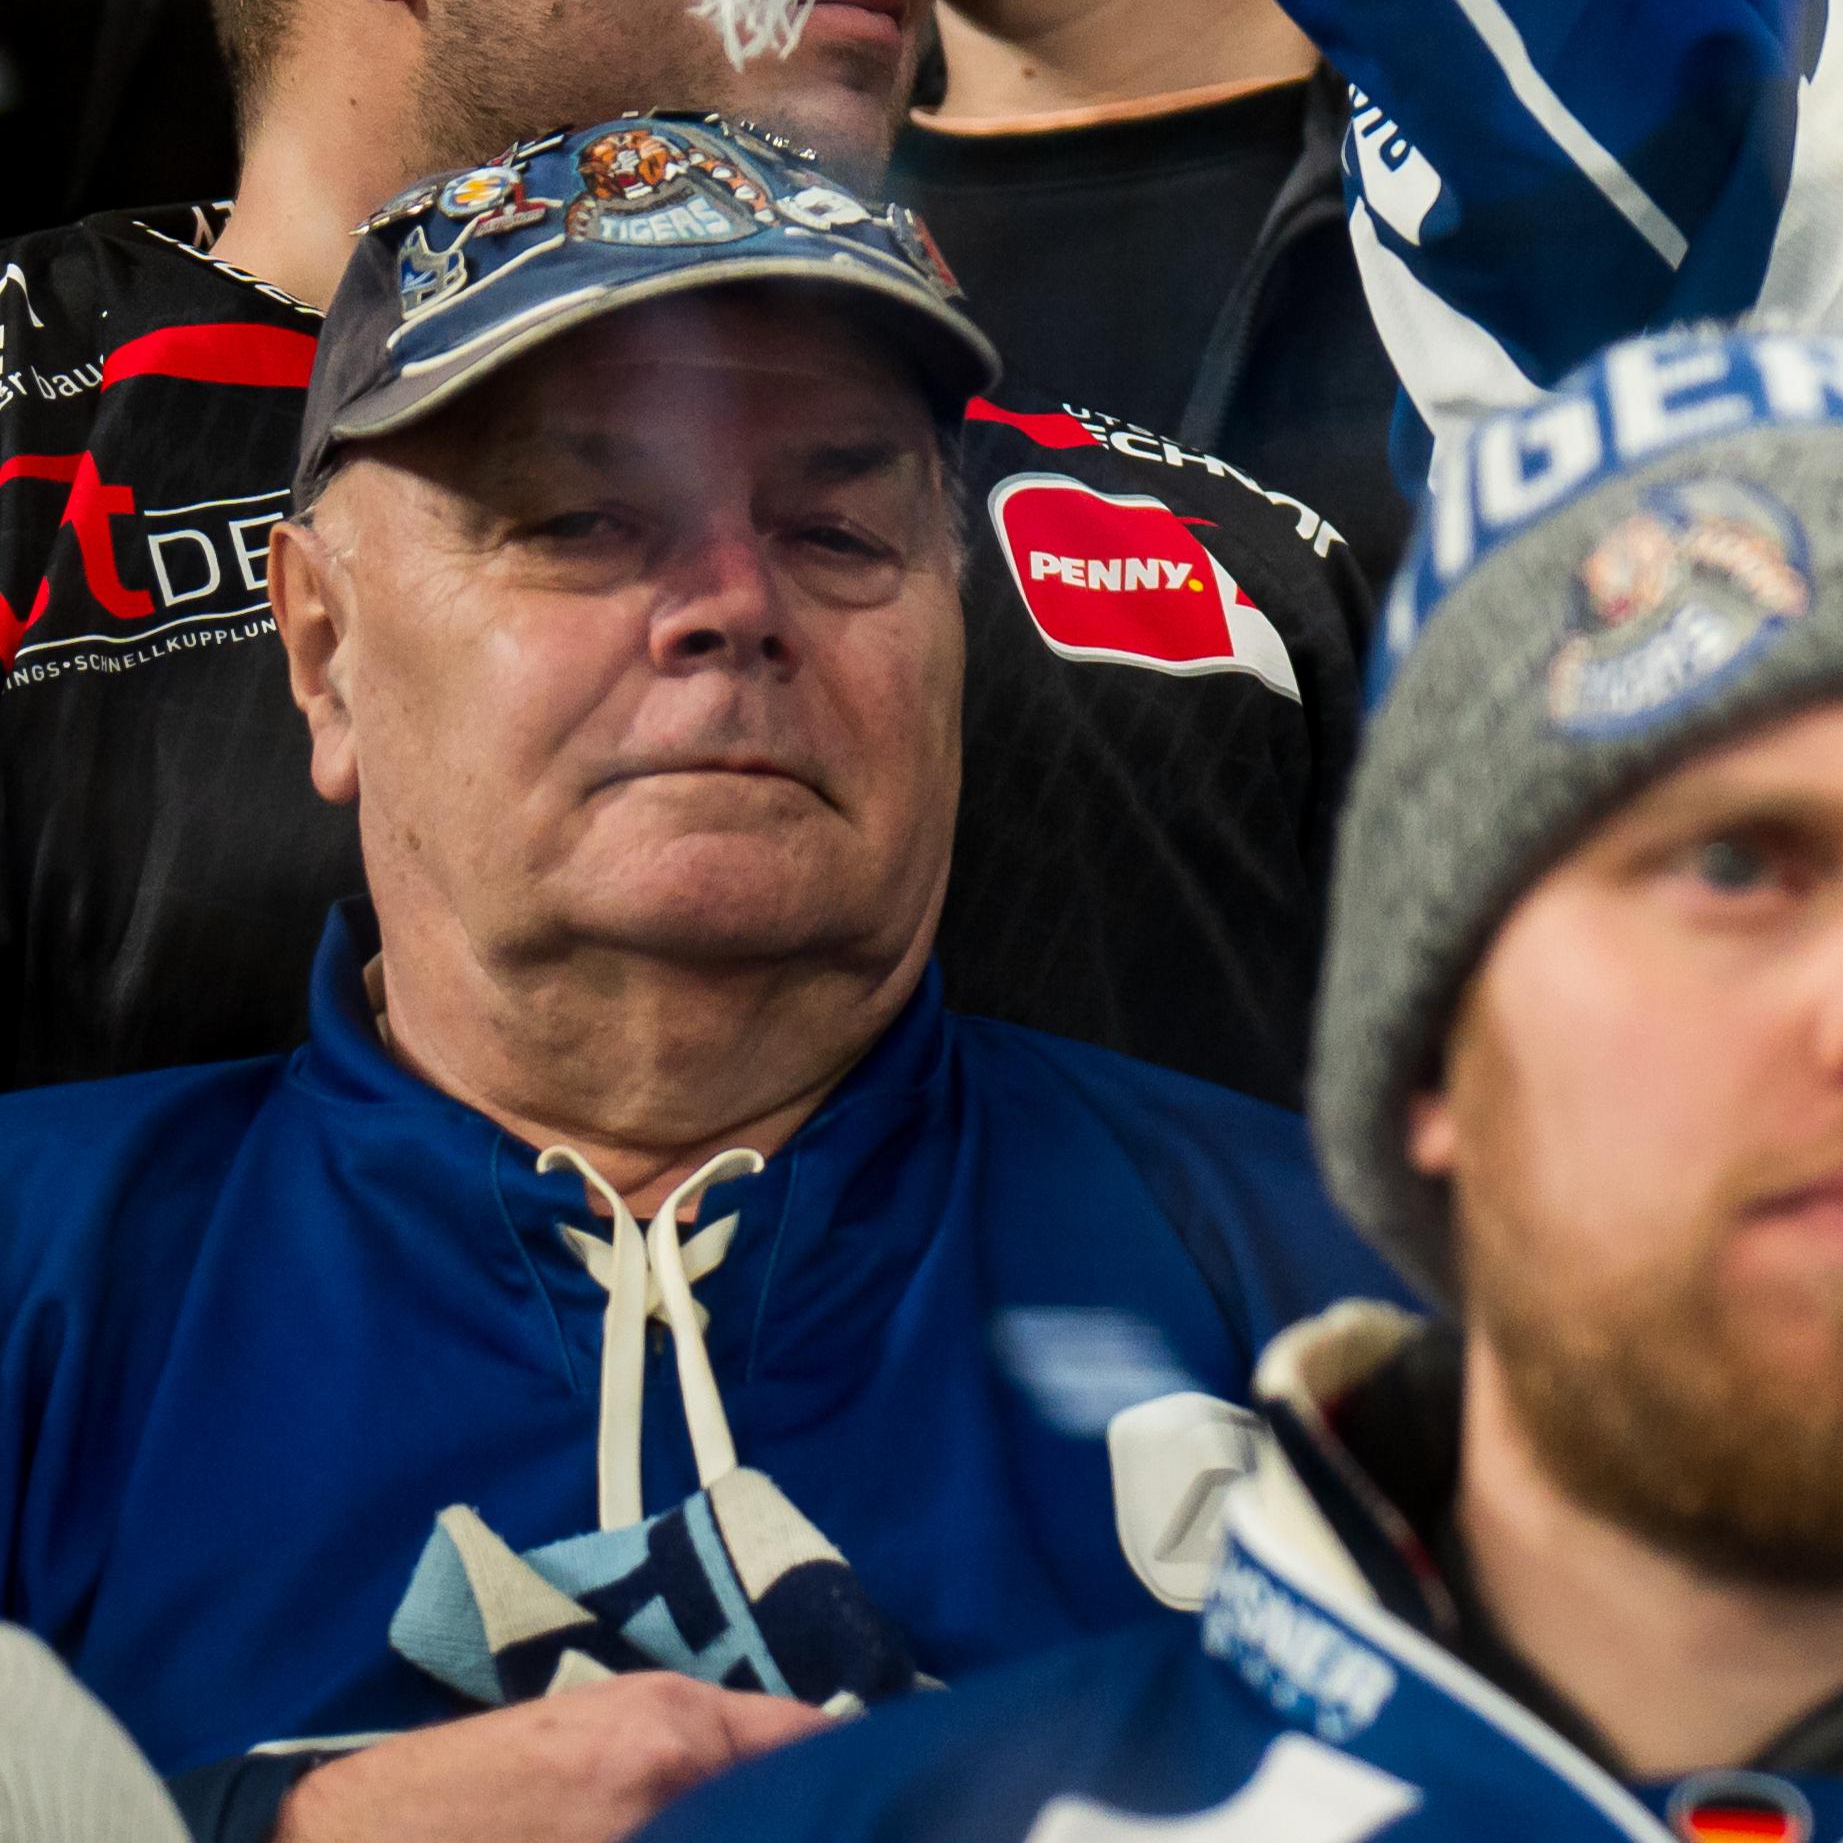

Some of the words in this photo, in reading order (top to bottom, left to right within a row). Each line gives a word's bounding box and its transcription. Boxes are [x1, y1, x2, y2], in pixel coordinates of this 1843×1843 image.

[600, 196, 731, 243] TIGERS
[147, 511, 284, 607] DE
[74, 617, 278, 674] SCHNELLKUPPLUN
